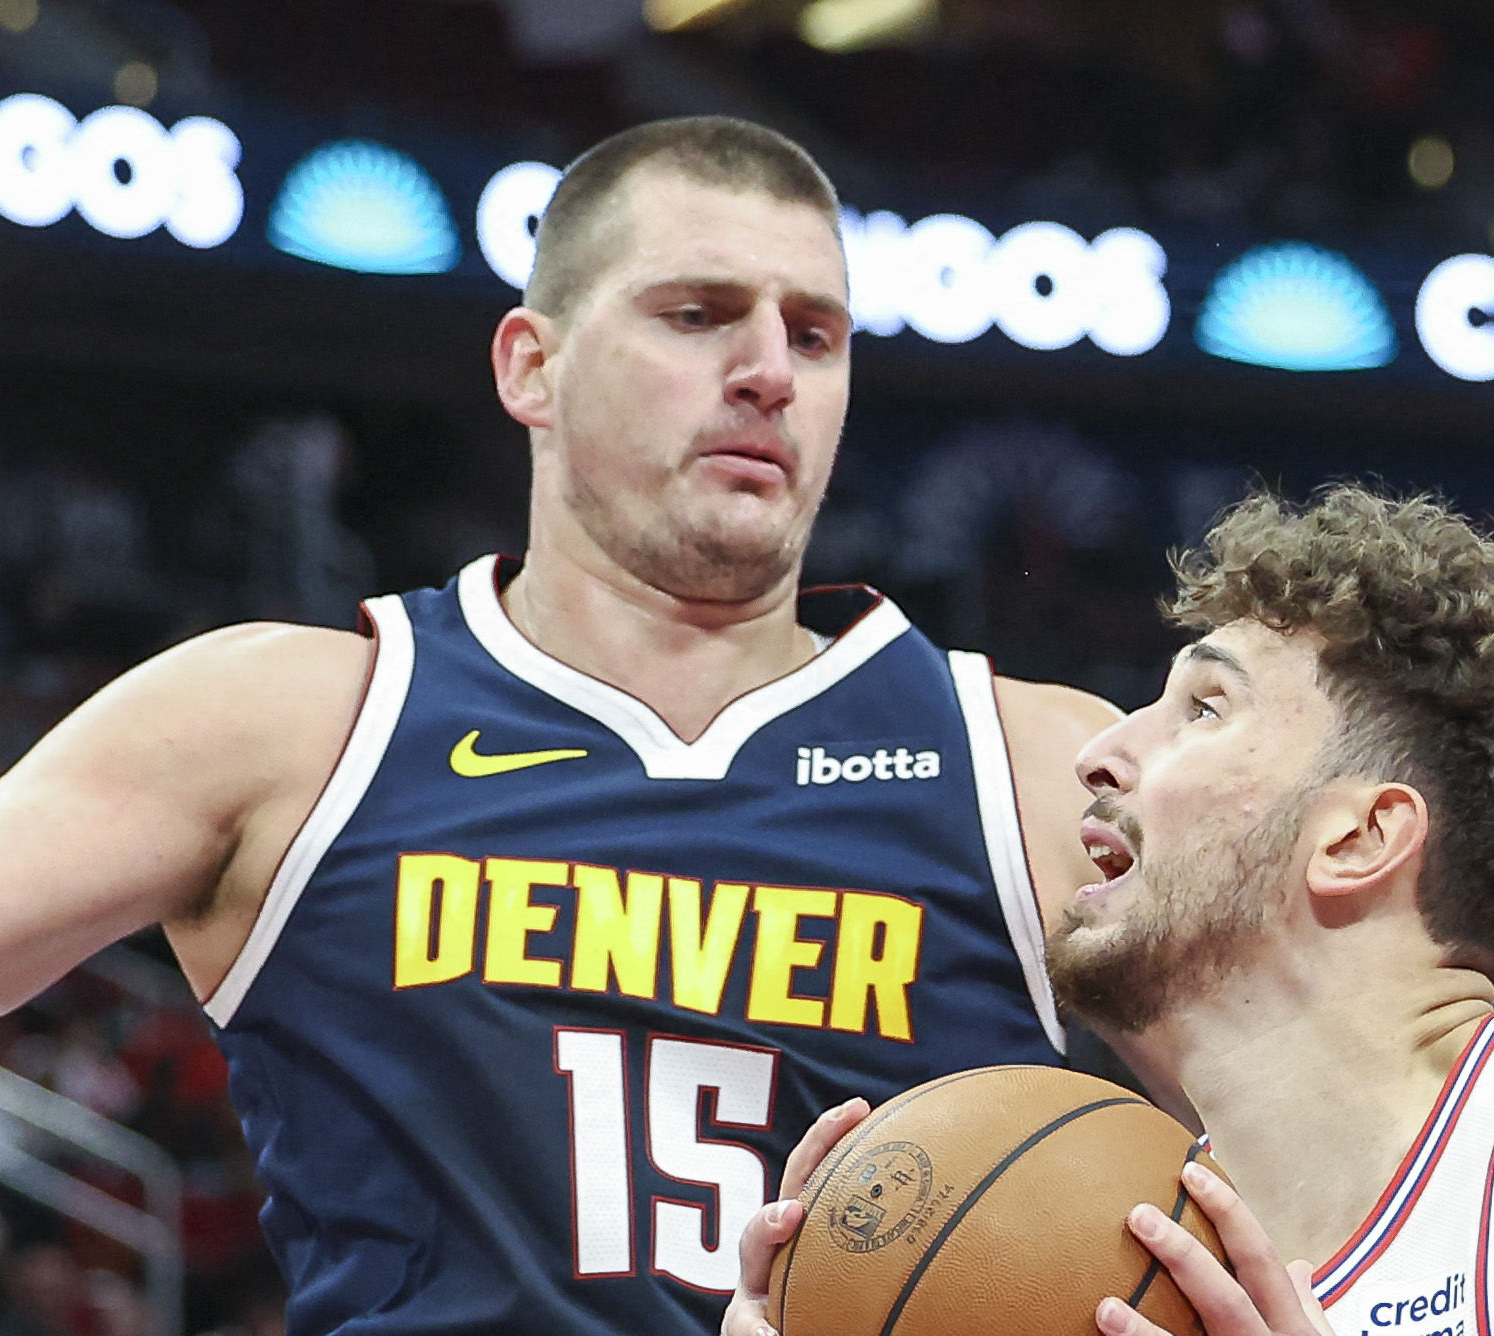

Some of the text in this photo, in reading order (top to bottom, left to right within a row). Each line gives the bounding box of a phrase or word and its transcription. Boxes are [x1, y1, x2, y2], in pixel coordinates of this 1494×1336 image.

[796, 746, 941, 786] ibotta
[393, 851, 925, 1044] DENVER
[552, 1025, 781, 1296] 15
[1370, 1273, 1466, 1327] credit
